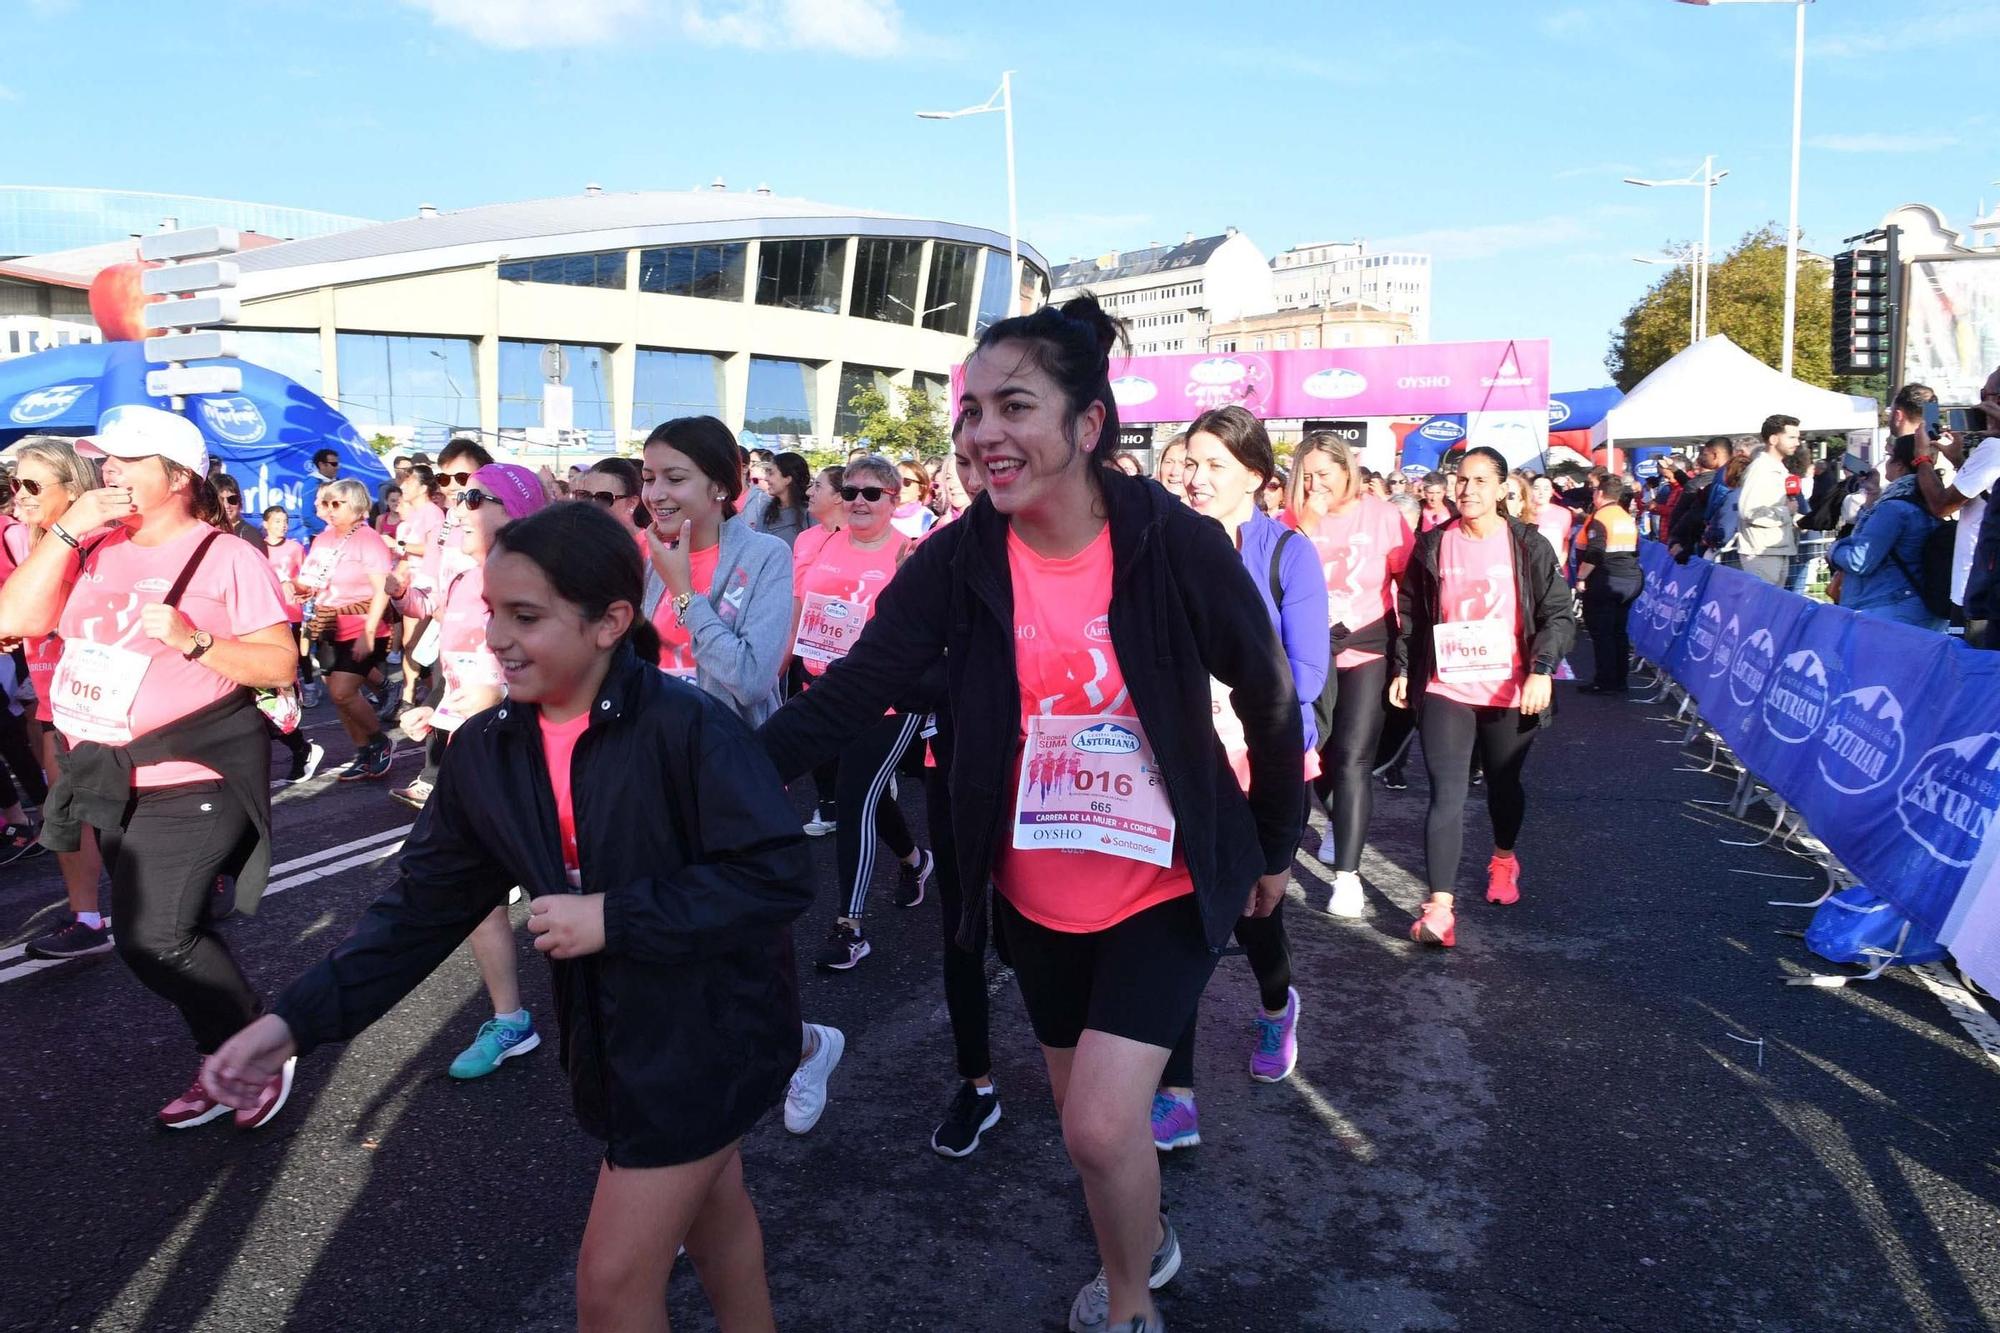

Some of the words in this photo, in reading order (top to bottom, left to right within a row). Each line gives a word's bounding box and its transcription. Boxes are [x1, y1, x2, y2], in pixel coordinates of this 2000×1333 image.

[1397, 376, 1451, 389] OYSHO
[821, 624, 843, 638] 016
[1461, 646, 1487, 657] 016
[71, 680, 102, 701] 016
[1039, 739, 1067, 748] SUMA
[1074, 769, 1133, 796] 016
[1091, 801, 1112, 813] 665
[1036, 813, 1068, 822] CARRERA
[1081, 814, 1091, 822] LA
[1093, 816, 1117, 827] MUJER
[1130, 823, 1157, 836] CORUÑA
[1033, 828, 1082, 841] OYSHO
[1112, 837, 1157, 855] Santander
